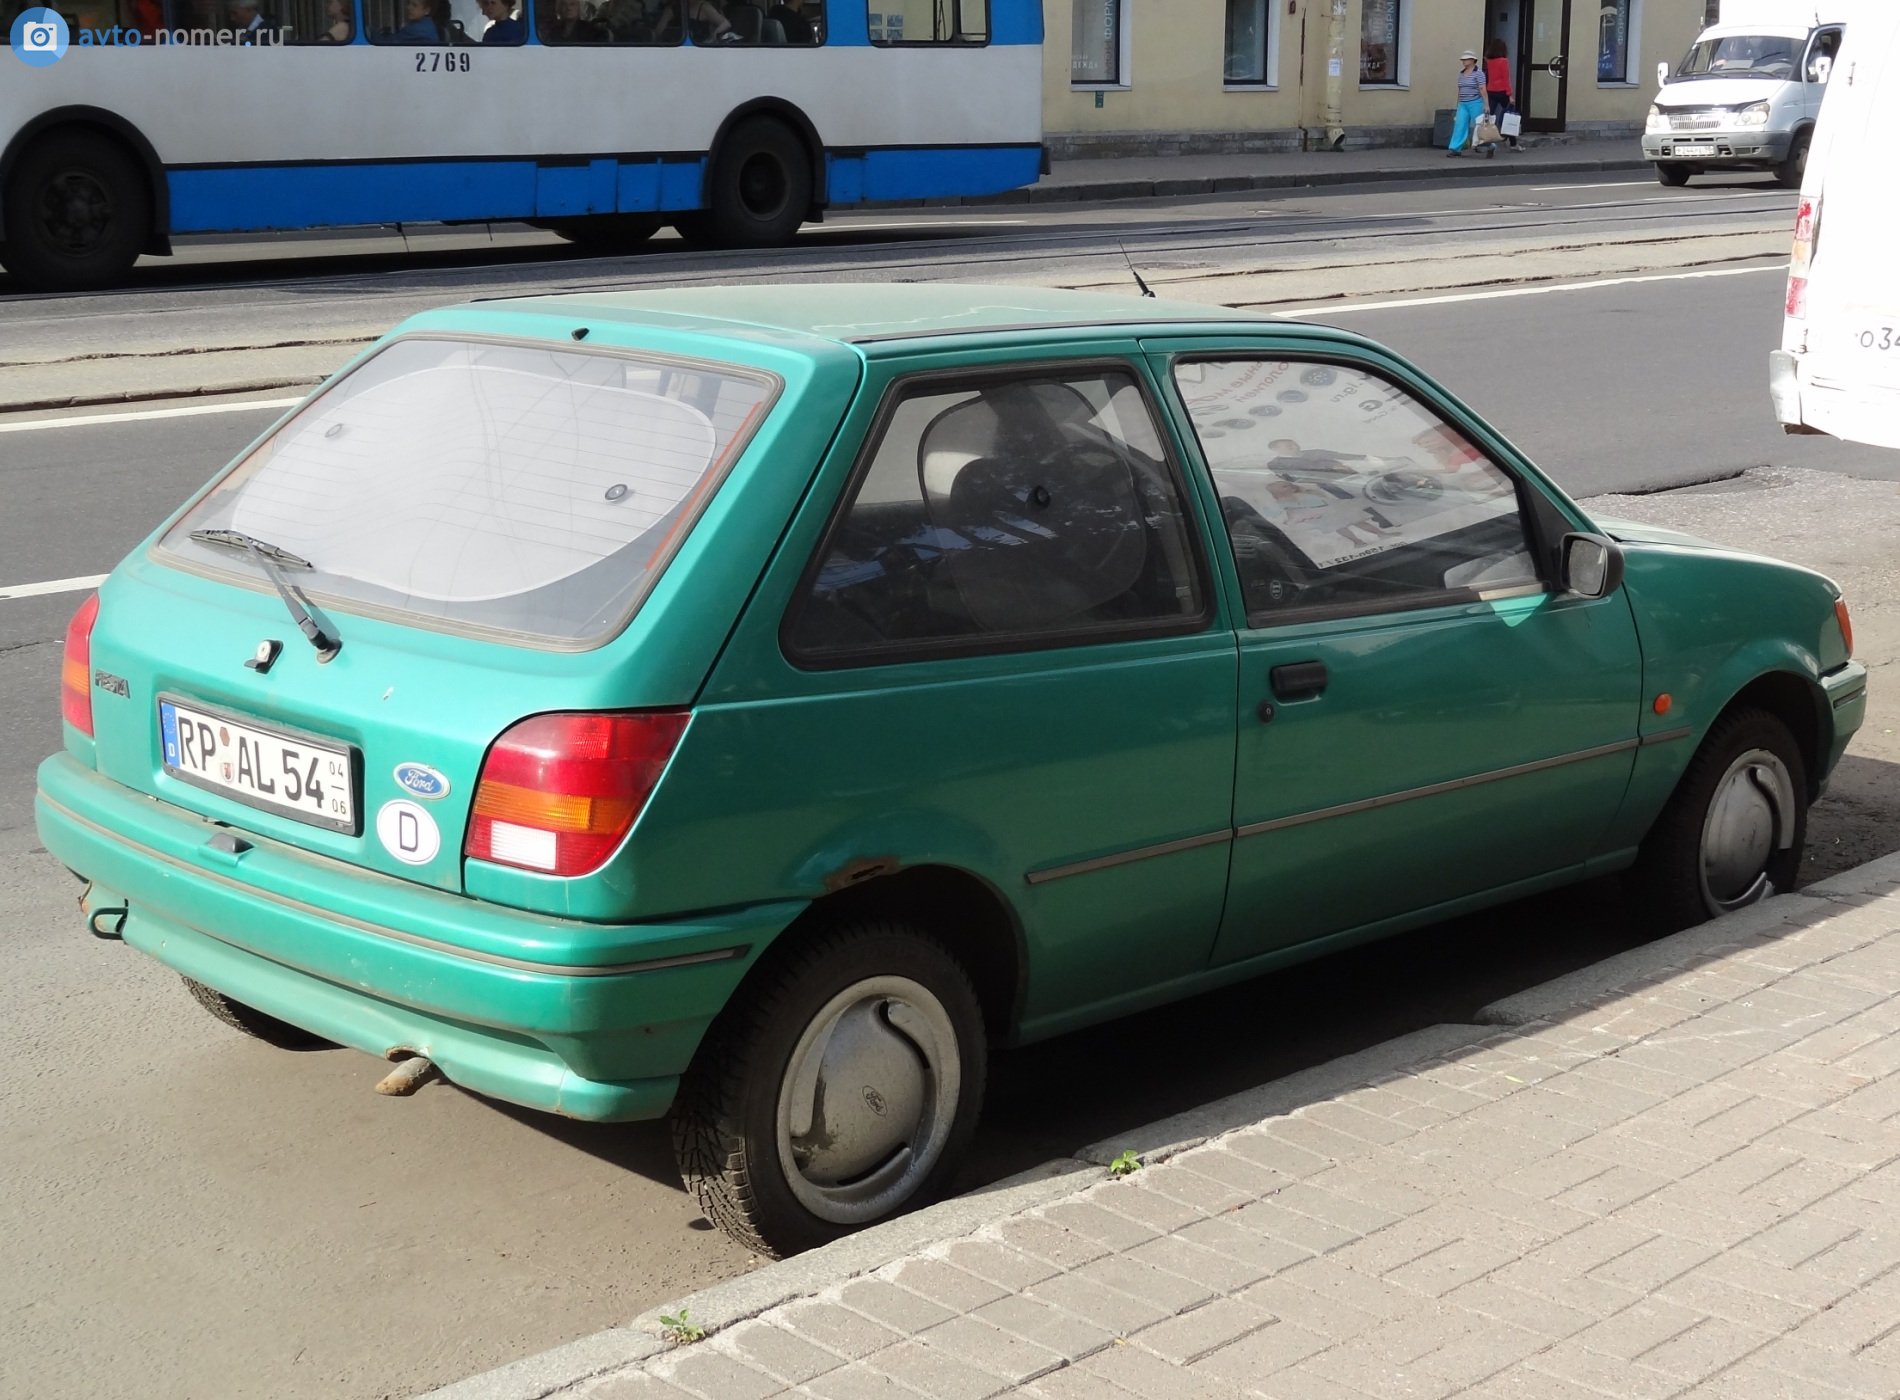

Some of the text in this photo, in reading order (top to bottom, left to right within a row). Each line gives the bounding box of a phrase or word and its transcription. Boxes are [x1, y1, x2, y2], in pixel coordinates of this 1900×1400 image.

[416, 52, 470, 72] 2769
[168, 743, 176, 758] D
[178, 716, 325, 808] RP AL 54
[329, 761, 344, 777] 04
[404, 769, 434, 791] Ford
[332, 798, 347, 815] 06
[399, 810, 418, 852] D
